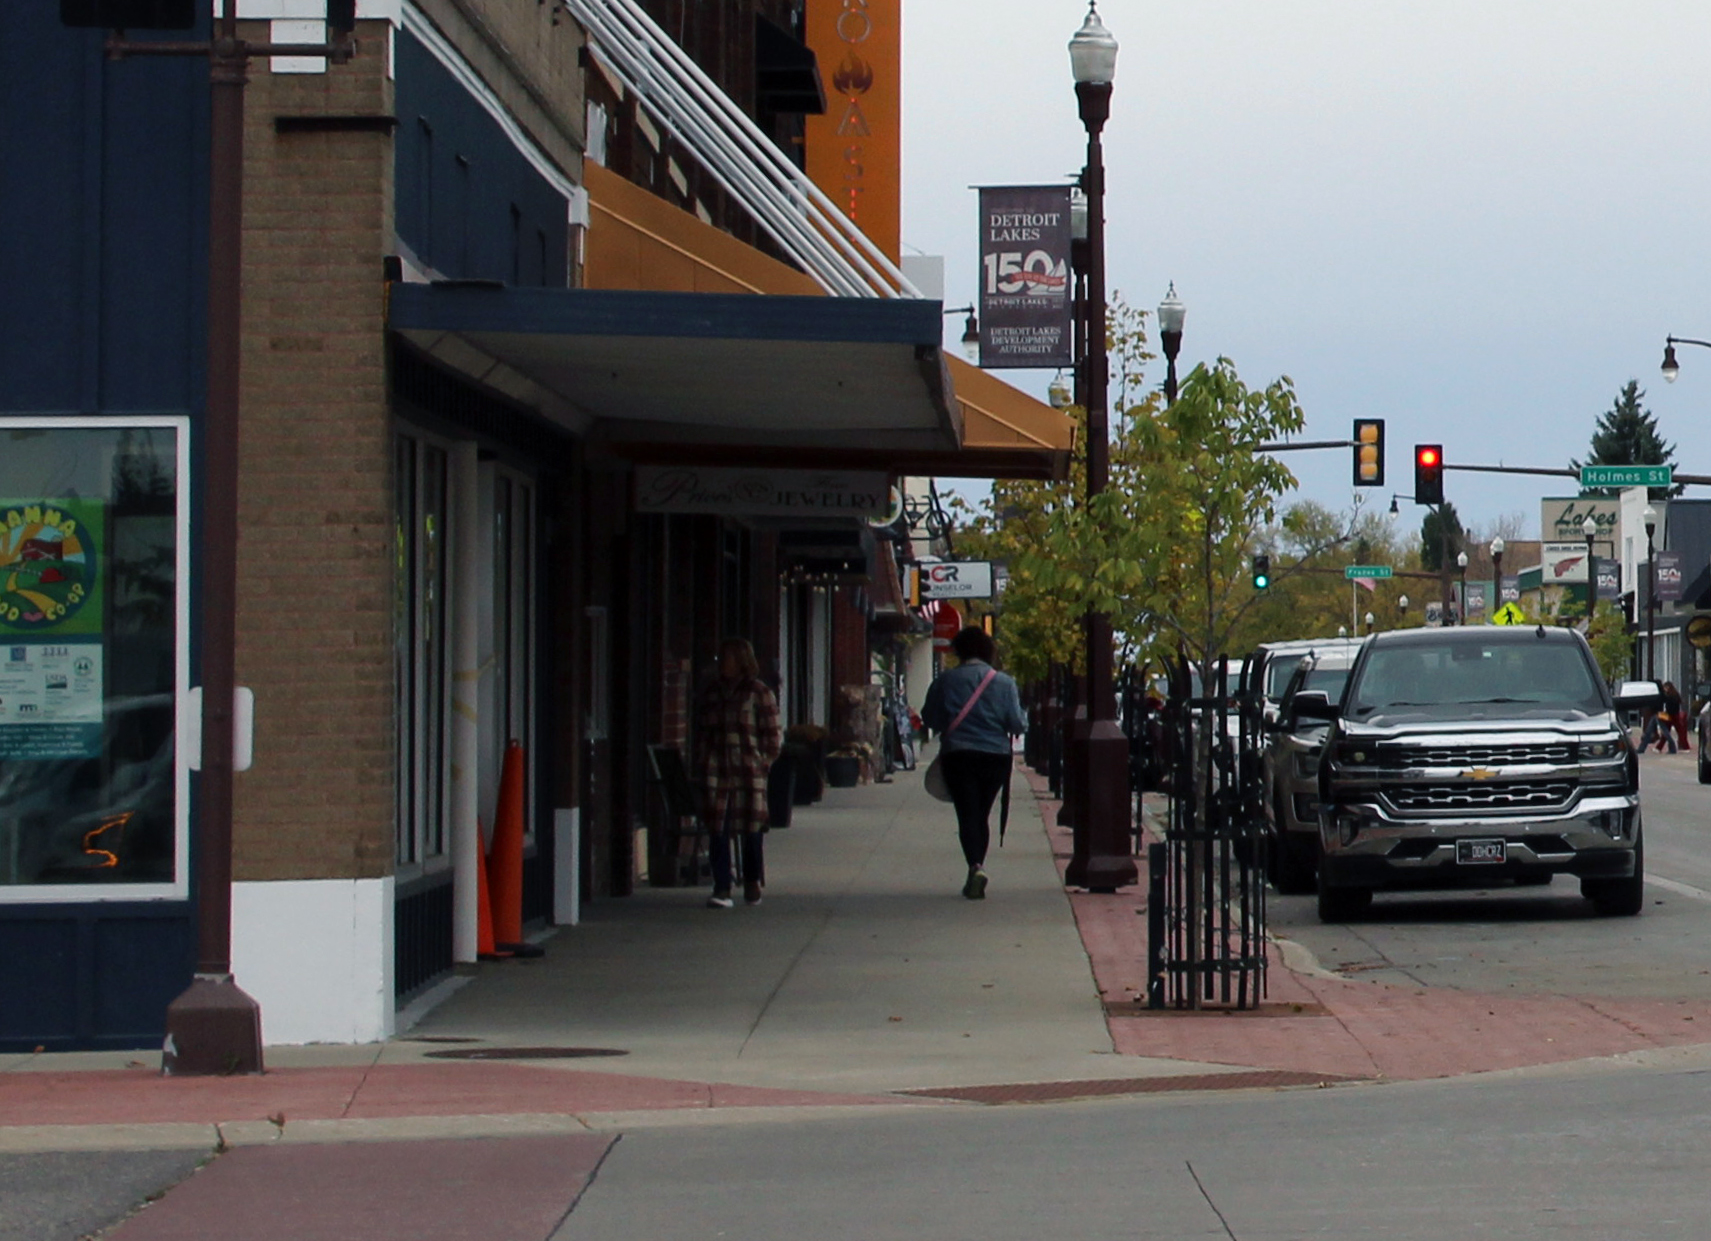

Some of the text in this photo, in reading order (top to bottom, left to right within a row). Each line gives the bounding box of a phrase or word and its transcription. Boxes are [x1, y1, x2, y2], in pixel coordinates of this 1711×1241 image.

[990, 213, 1061, 227] DETROIT
[990, 228, 1041, 242] LAKES
[984, 249, 1054, 295] 150
[990, 326, 1062, 336] DETROIT LAKES
[991, 336, 1060, 346] DEVELOPMENT
[999, 345, 1053, 354] AUTHORITY
[1587, 470, 1664, 482] Holmes St
[769, 491, 881, 510] JEWELRY
[1555, 502, 1618, 526] Lakes
[931, 566, 959, 582] CR
